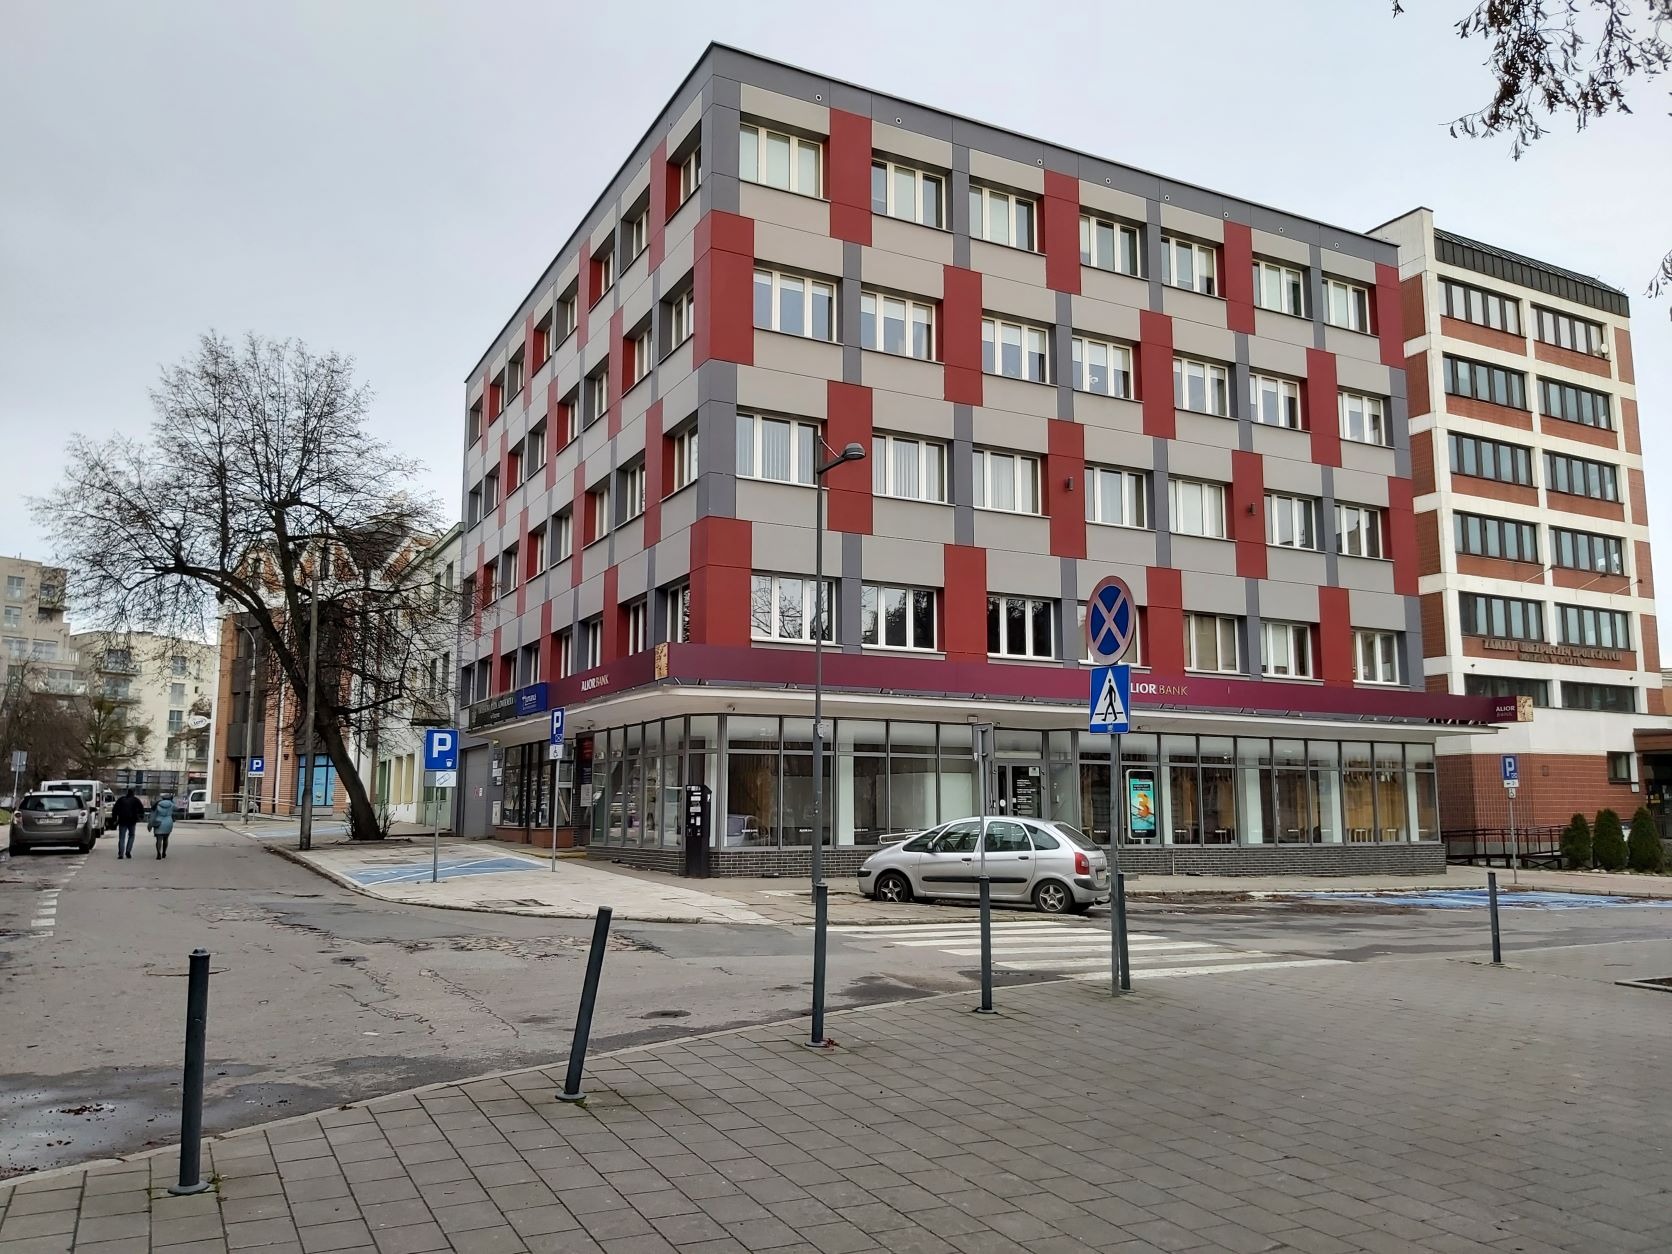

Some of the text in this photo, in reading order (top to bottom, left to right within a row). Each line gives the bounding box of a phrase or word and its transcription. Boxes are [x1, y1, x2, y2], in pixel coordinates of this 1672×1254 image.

[581, 674, 609, 692] ALIOR BANK
[1130, 682, 1189, 696] LIOR BANK
[553, 711, 562, 735] P
[432, 732, 452, 758] P
[253, 760, 262, 771] P
[1505, 757, 1515, 777] P
